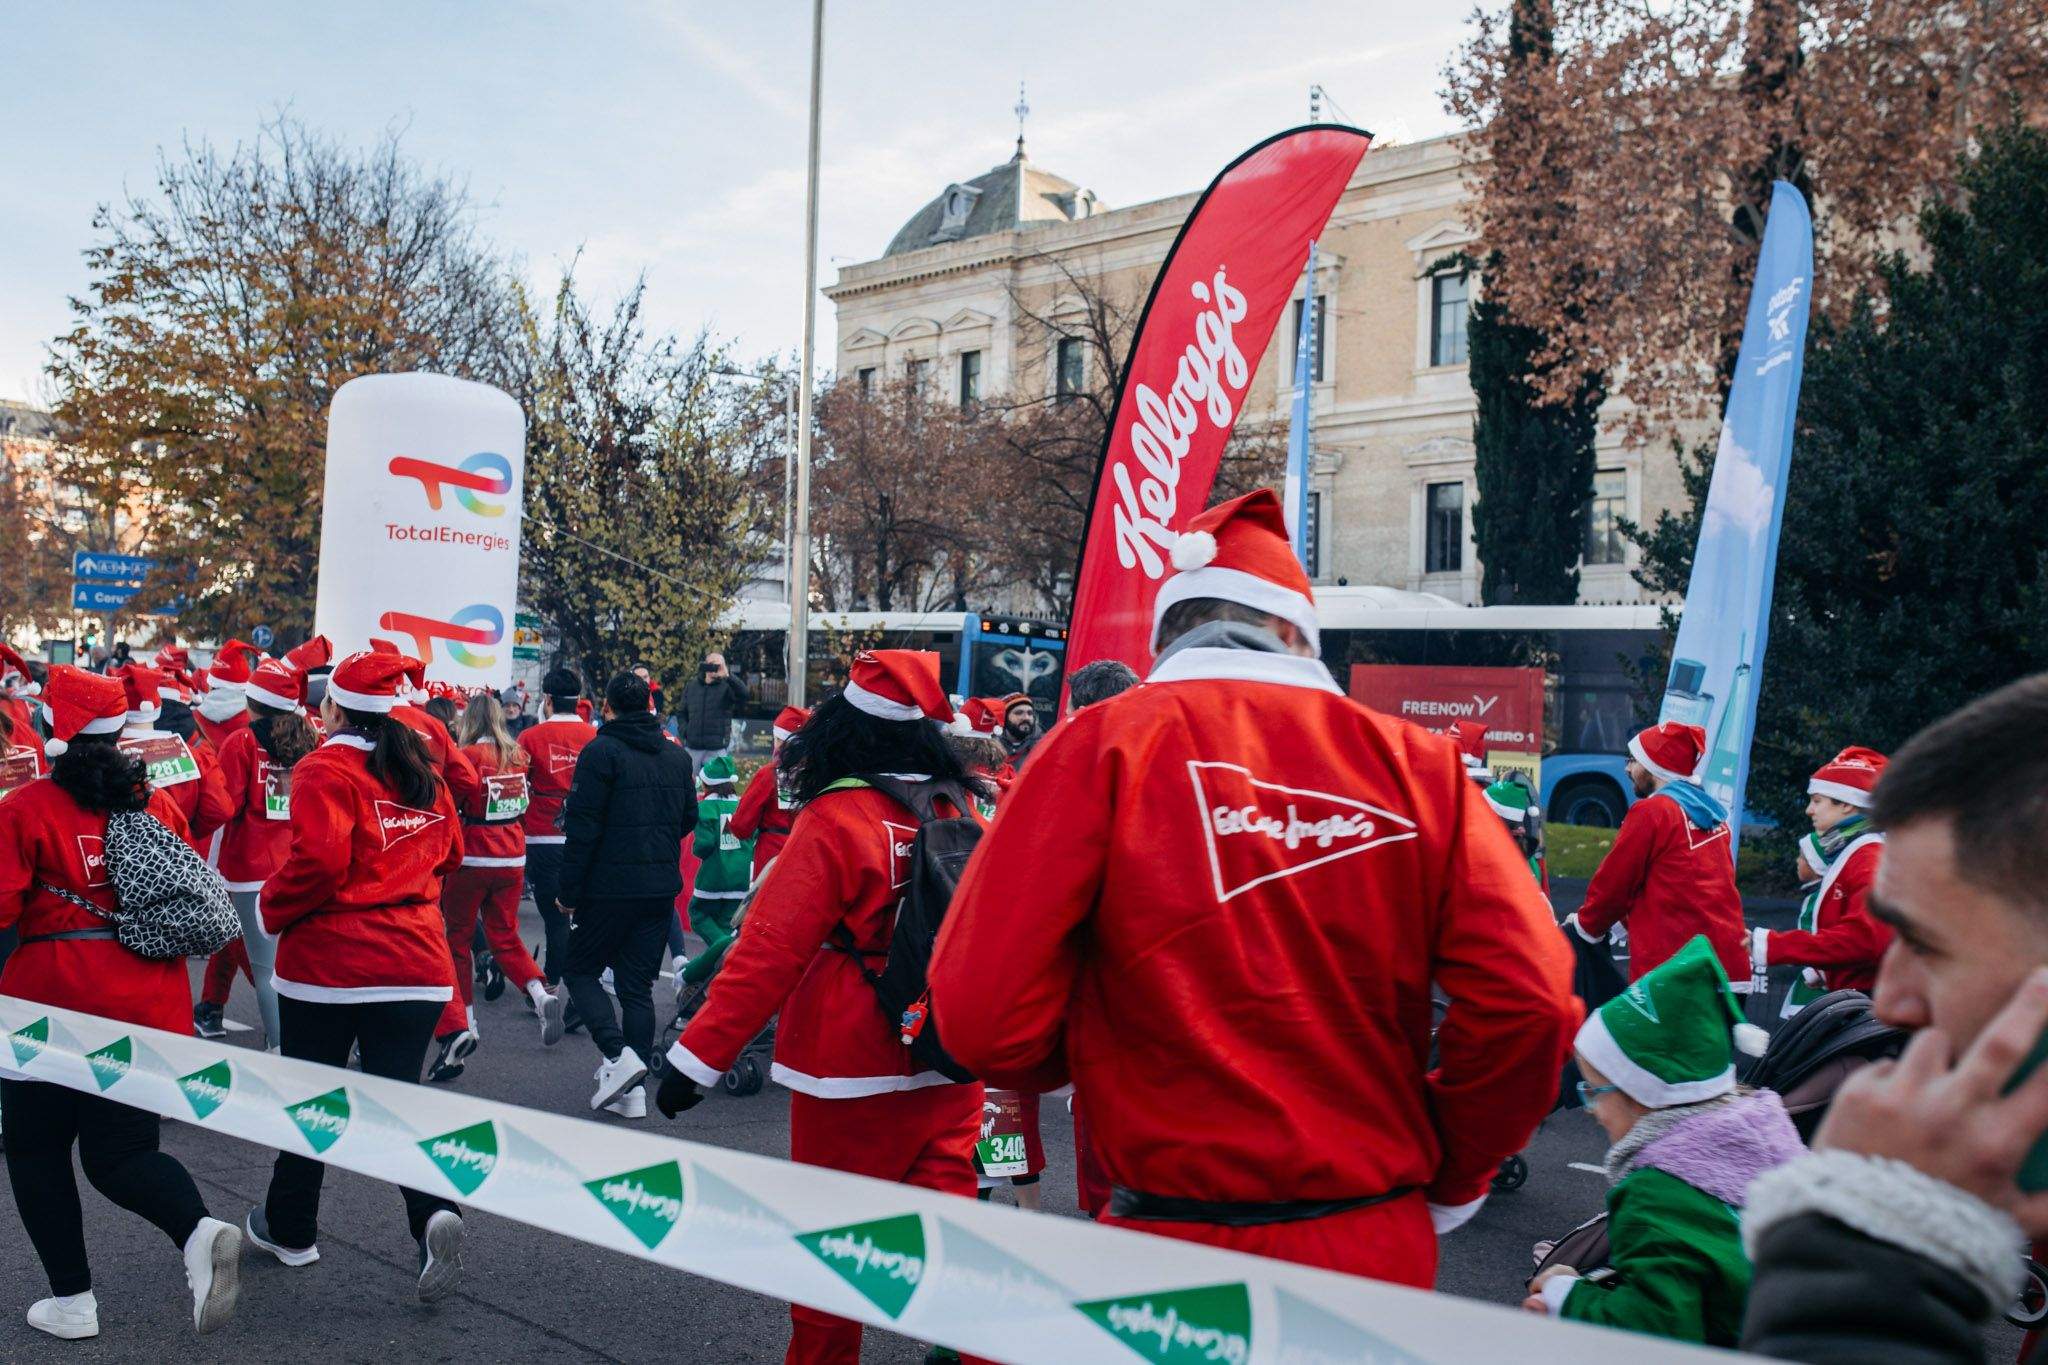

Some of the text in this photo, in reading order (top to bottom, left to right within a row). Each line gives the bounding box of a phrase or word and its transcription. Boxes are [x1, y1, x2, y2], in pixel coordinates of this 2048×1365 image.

[1113, 271, 1249, 580] Kellogg's
[384, 522, 510, 552] TotalEnergies
[78, 591, 130, 604] A Coru
[1402, 700, 1474, 716] FREENOW
[1484, 730, 1525, 743] MERO
[1528, 733, 1535, 743] 1
